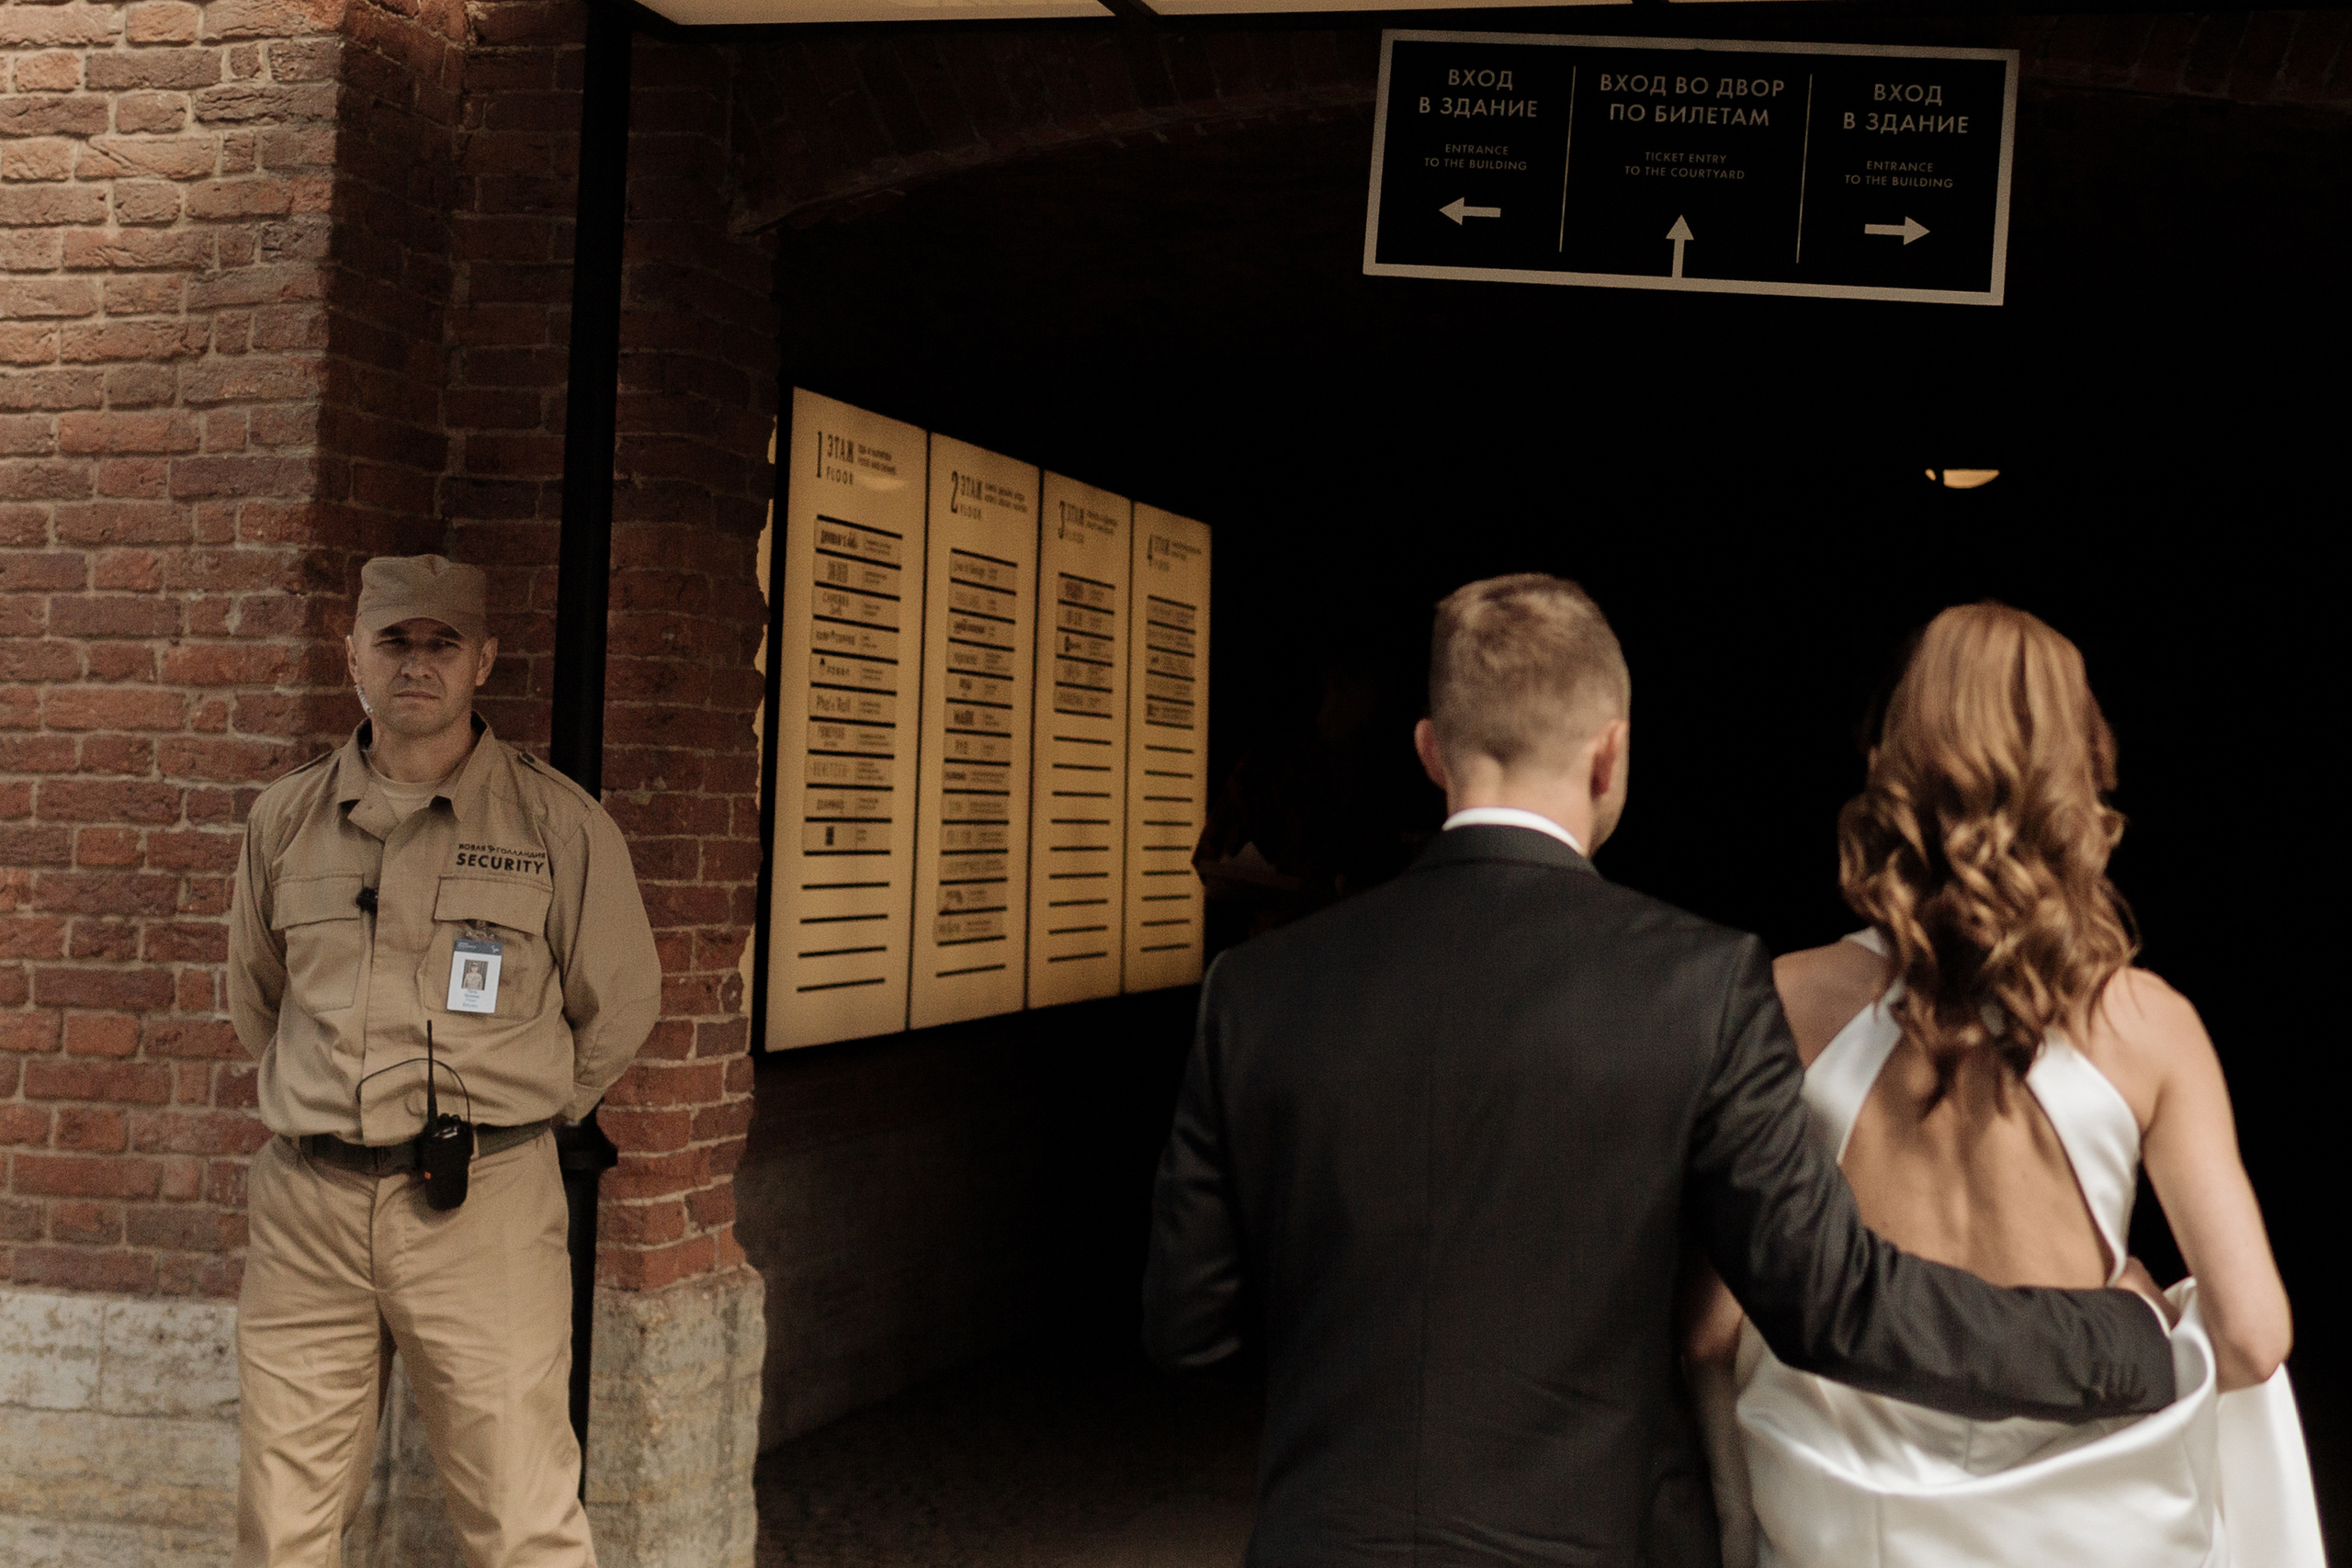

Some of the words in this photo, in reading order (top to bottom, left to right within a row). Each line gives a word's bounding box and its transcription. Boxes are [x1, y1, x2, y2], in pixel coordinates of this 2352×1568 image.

[1448, 69, 1513, 91] ВХОД
[1600, 73, 1667, 96] ВХОД
[1675, 76, 1709, 95] ВО
[1715, 77, 1785, 99] ДВОР
[1873, 83, 1943, 107] ВХОД
[1419, 96, 1431, 114] В
[1440, 96, 1537, 118] ЗДАНИЕ
[1610, 103, 1646, 122] ПО
[1655, 105, 1770, 126] БИЛЕТАМ
[1843, 111, 1856, 130] В
[1865, 112, 1969, 135] ЗДАНИЕ
[1444, 143, 1509, 155] ENTRANCE
[1645, 151, 1685, 163] TICKET
[1688, 153, 1727, 164] ENTRY
[1424, 157, 1441, 168] TO
[1443, 158, 1464, 169] THE
[1468, 159, 1528, 171] BUILDING
[1624, 165, 1641, 175] TO
[1645, 165, 1667, 176] THE
[1670, 167, 1745, 180] COURTYARD
[1866, 160, 1933, 173] ENTRANCE
[1845, 174, 1861, 185] TO
[1866, 175, 1887, 186] THE
[1892, 175, 1953, 188] BUILDING
[817, 431, 822, 478] 1
[827, 434, 854, 463] ЭТАЖ
[826, 466, 854, 485] FLOOR
[951, 470, 958, 513] 2
[458, 843, 486, 852] НОВАЯ
[496, 847, 547, 859] ГОЛЛАНДИЯ
[456, 852, 545, 874] SECURITY
